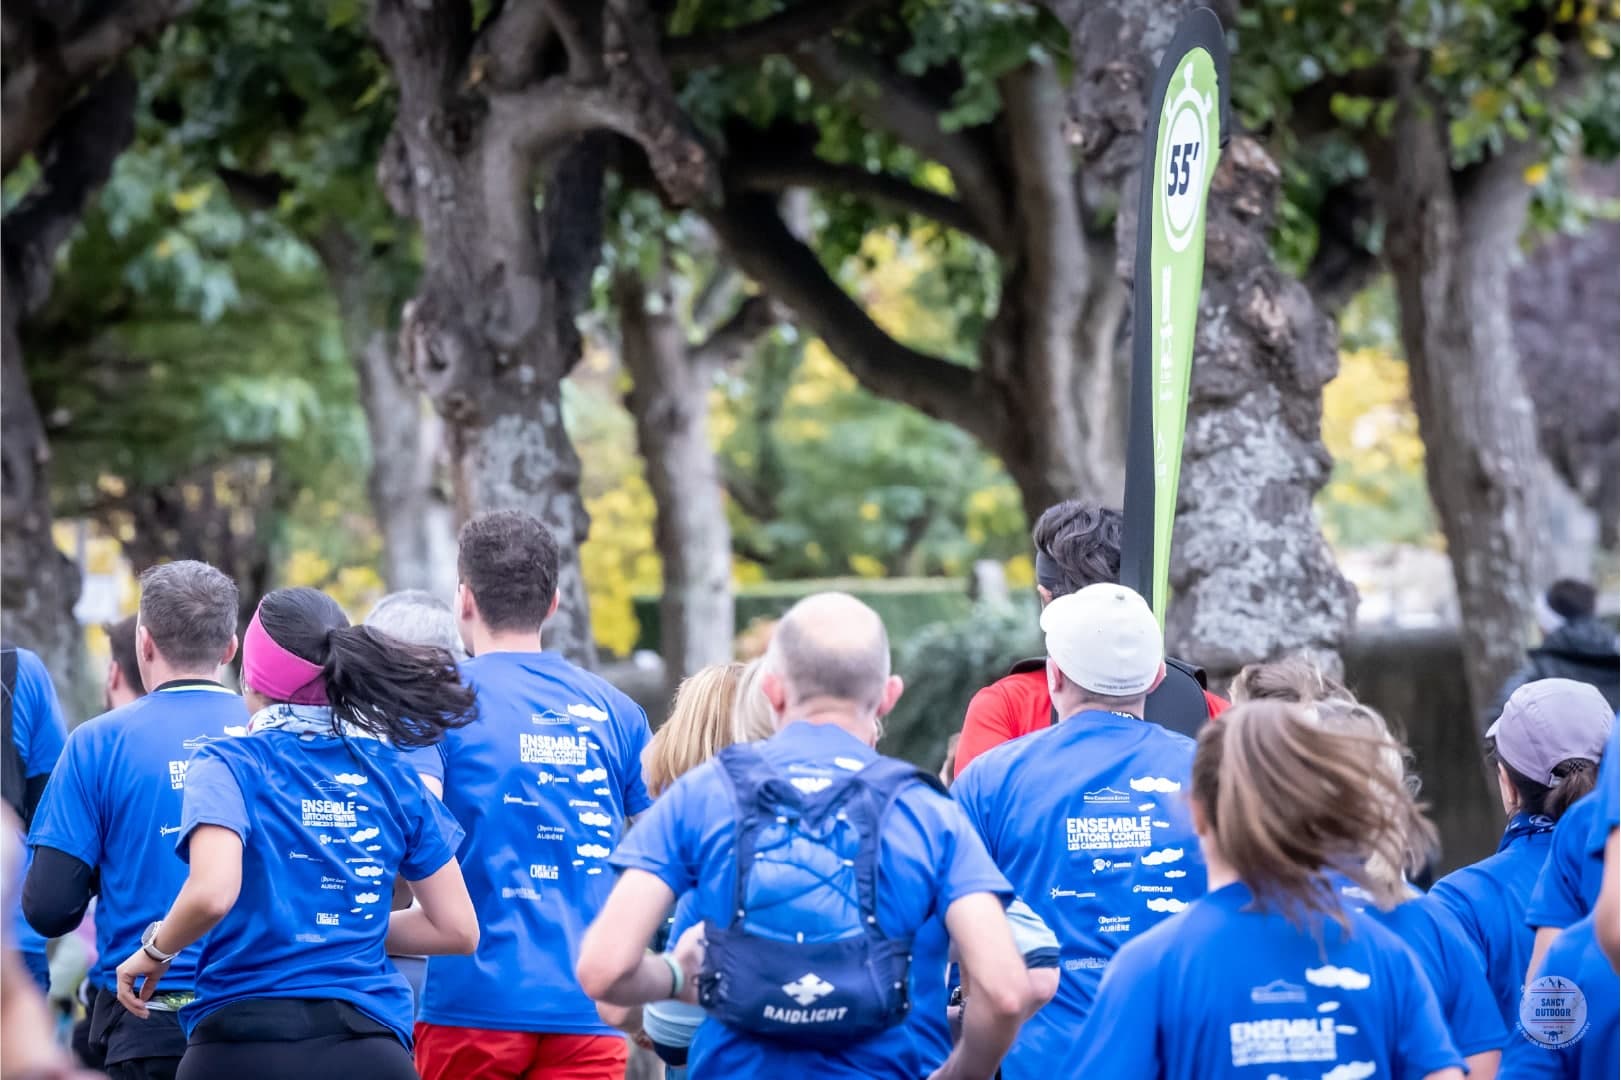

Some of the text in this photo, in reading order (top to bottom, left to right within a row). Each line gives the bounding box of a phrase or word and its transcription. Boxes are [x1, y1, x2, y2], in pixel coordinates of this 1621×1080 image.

[1167, 142, 1200, 197] 55'
[520, 733, 587, 750] ENSEMBLE
[1066, 816, 1151, 833] ENSEMBLE
[1067, 830, 1152, 843] LUTTONS CONTRE
[763, 1005, 849, 1024] RAIDLIGHT
